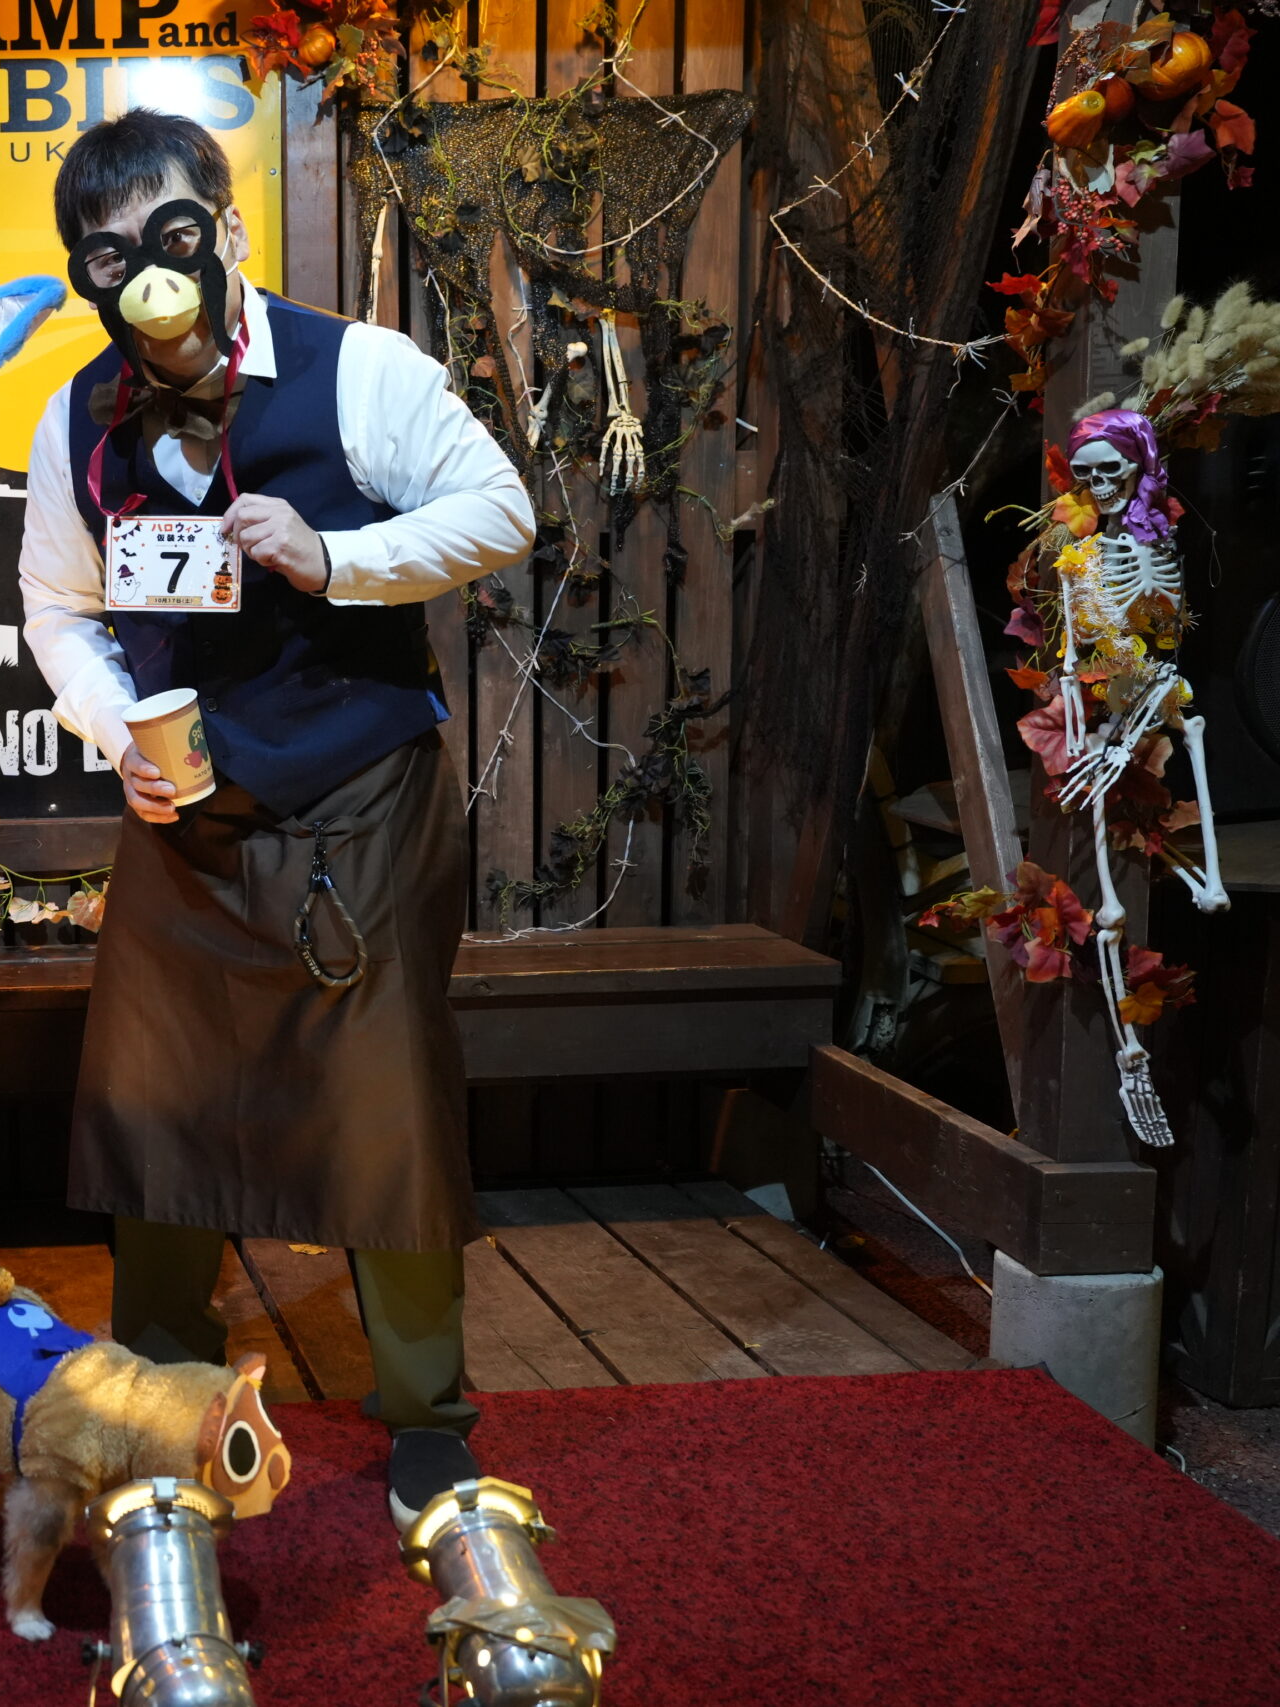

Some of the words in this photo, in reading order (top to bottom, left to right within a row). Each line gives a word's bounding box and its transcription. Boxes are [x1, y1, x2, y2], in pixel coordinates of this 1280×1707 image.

[158, 12, 240, 47] and
[151, 522, 204, 534] ハロウィン
[156, 533, 196, 543] 仮装大会
[160, 551, 190, 594] 7
